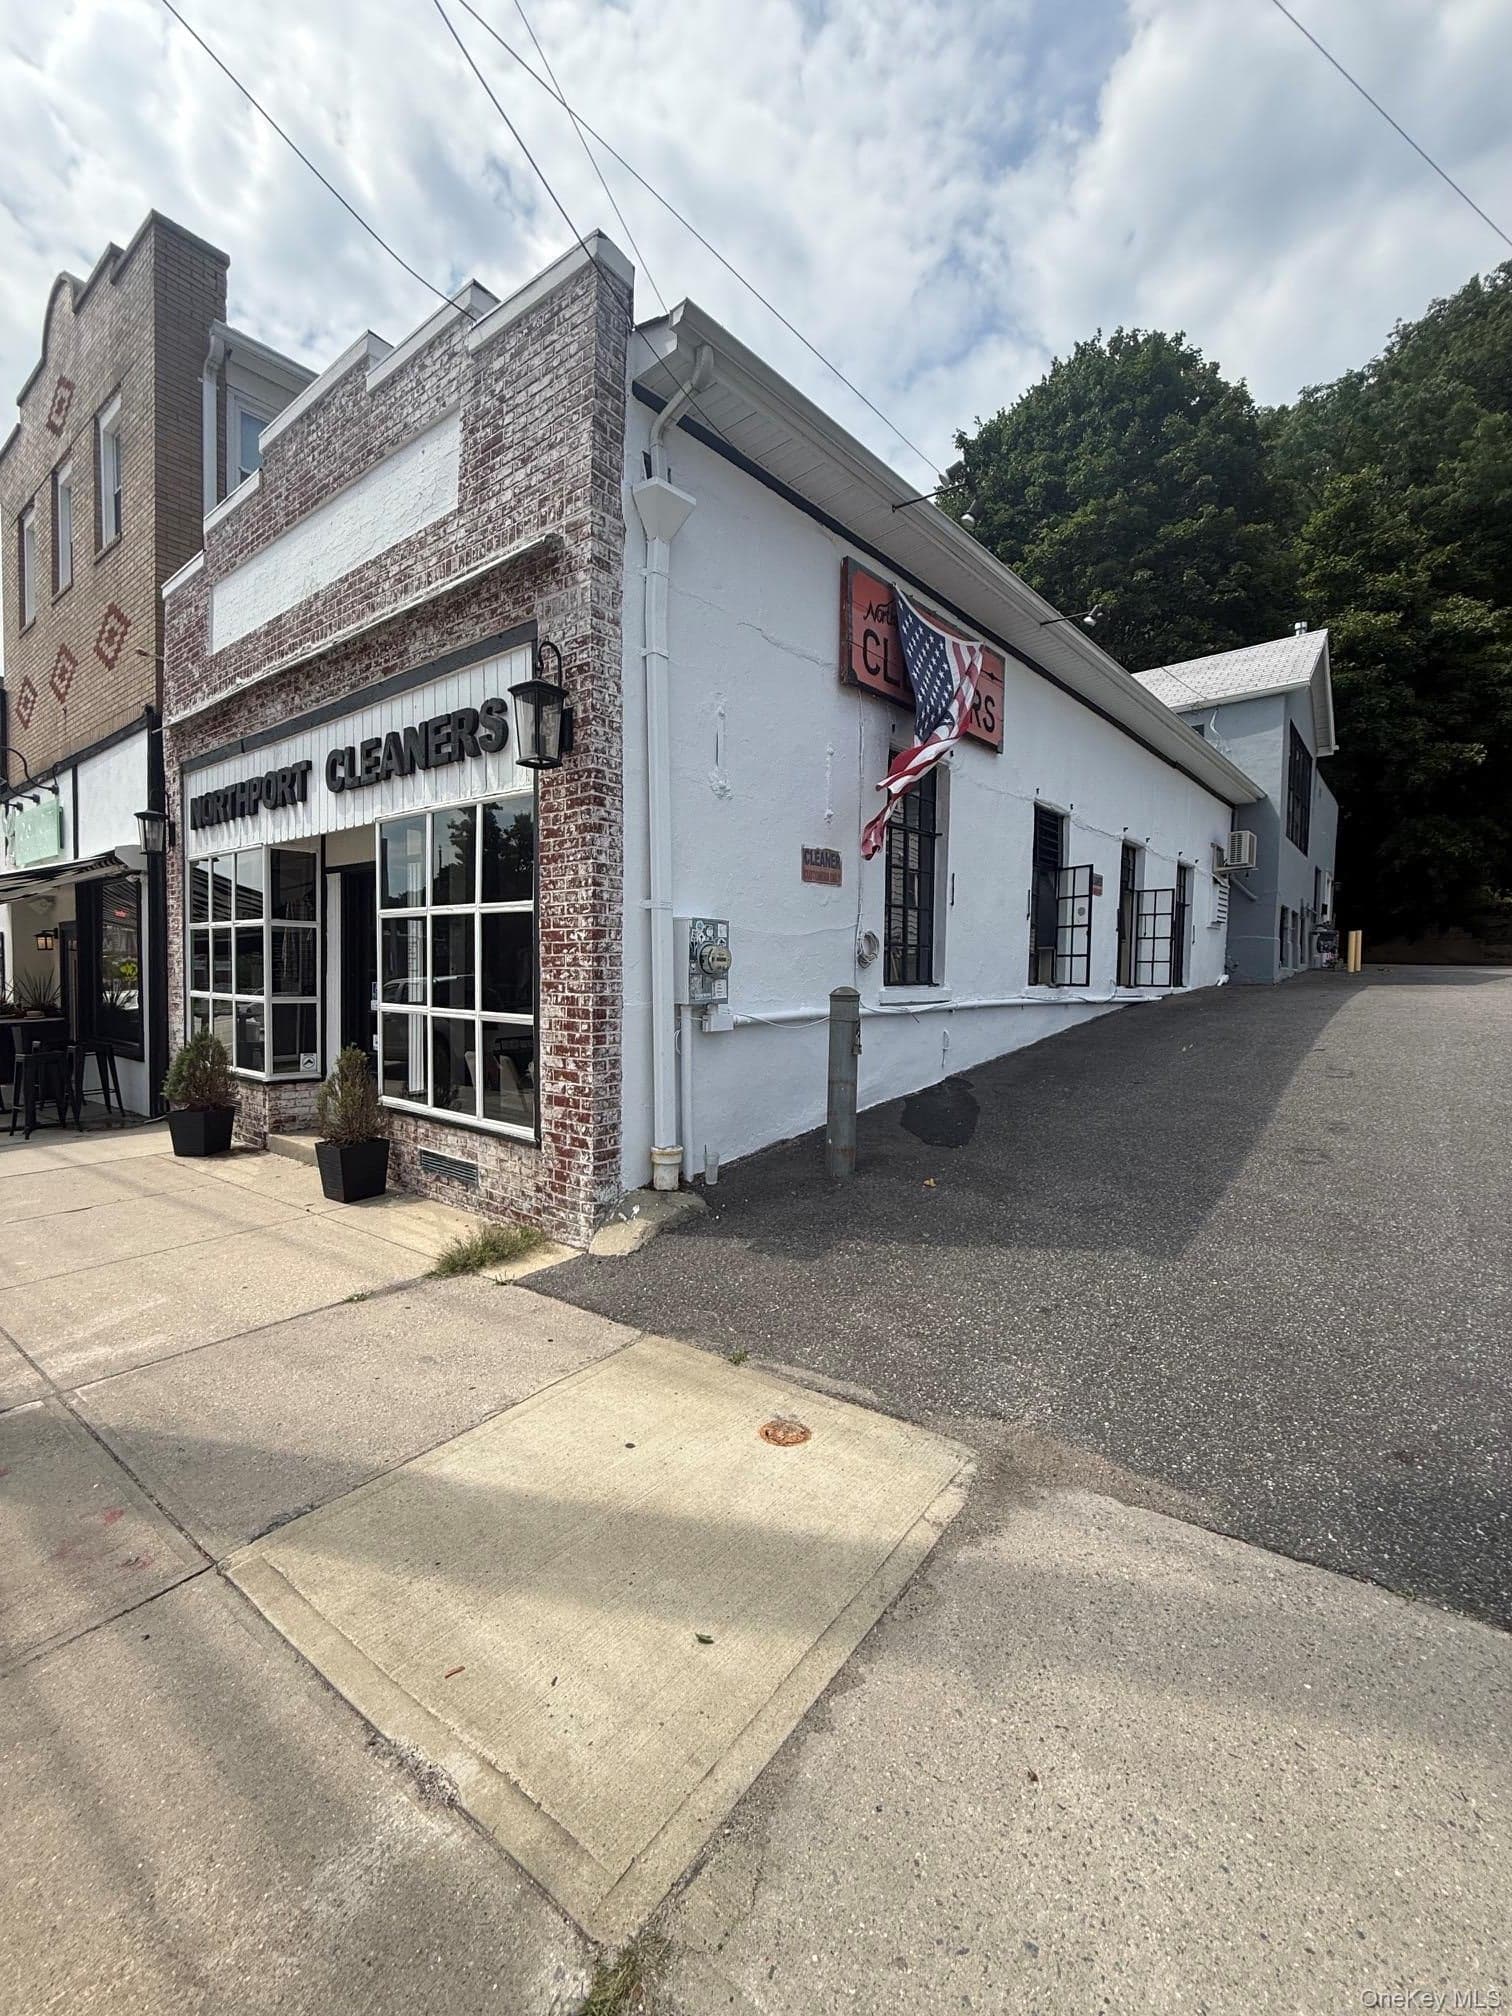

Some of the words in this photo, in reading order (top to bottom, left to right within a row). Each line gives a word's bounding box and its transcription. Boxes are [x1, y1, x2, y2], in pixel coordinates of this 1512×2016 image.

[862, 628, 995, 733] CLRS
[190, 760, 312, 831] NORTHPORT
[325, 697, 508, 794] CLEANERS
